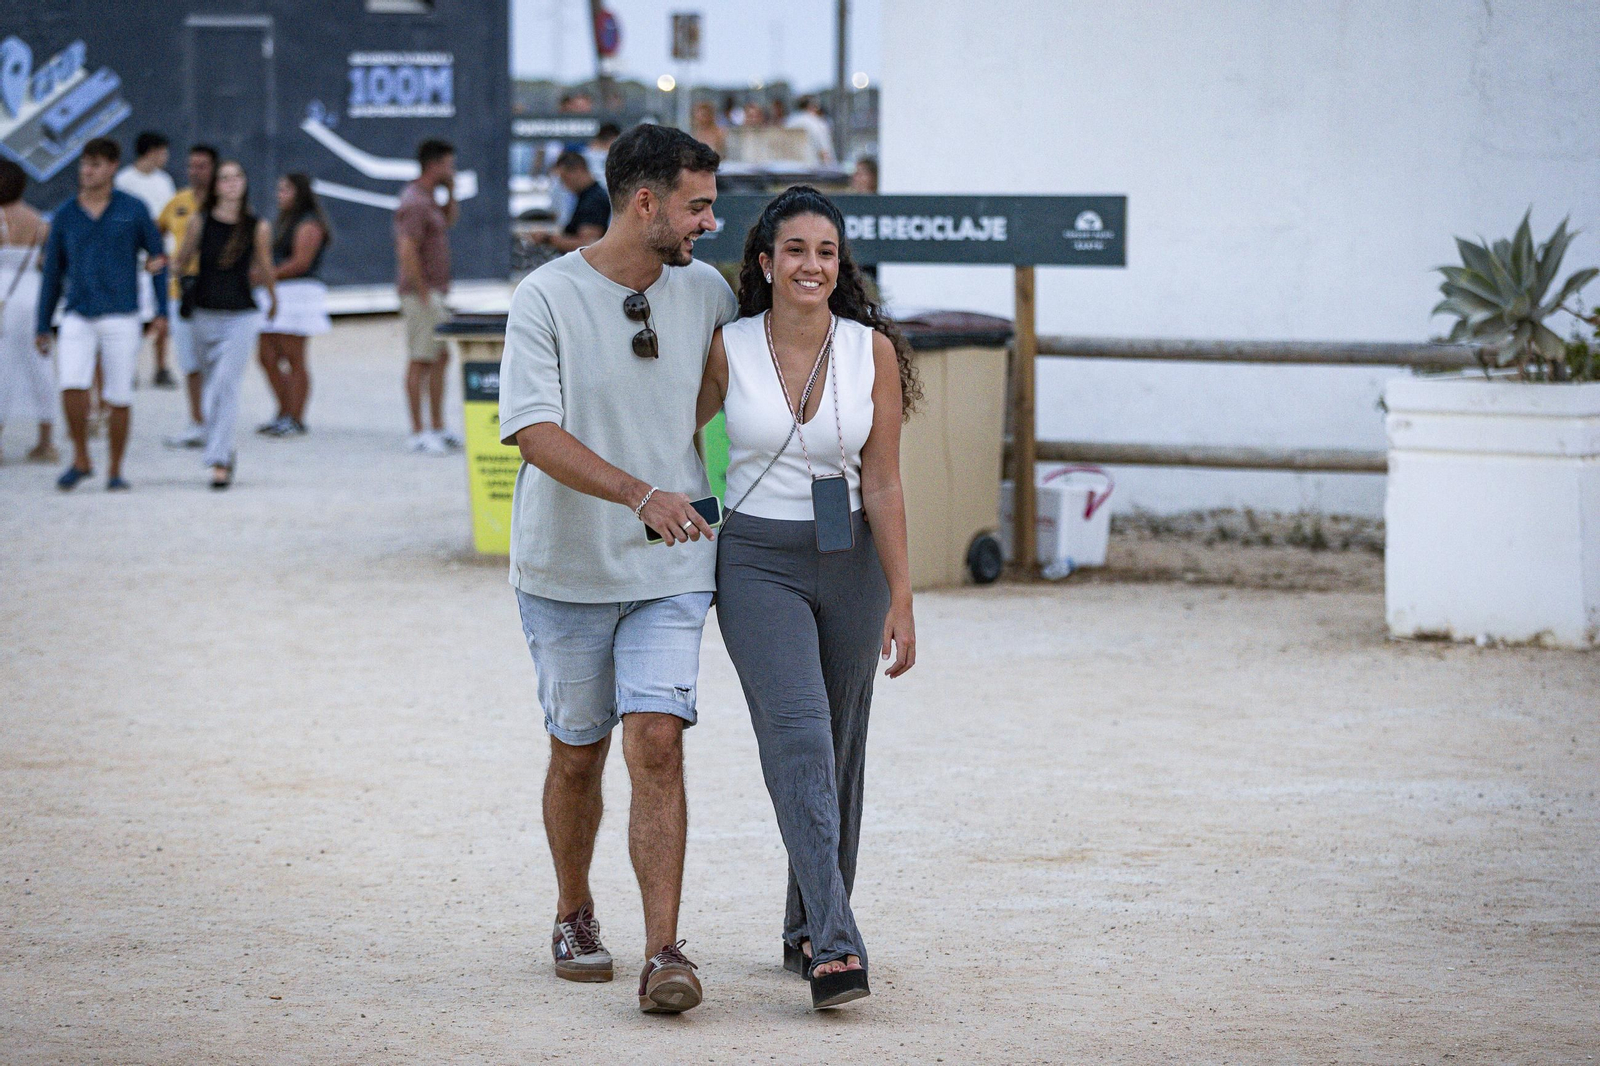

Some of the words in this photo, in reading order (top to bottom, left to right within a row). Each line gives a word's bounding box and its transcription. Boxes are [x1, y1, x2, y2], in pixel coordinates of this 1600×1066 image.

[349, 66, 453, 106] 100M
[846, 216, 876, 240] DE
[878, 216, 1007, 241] RECICLAJE
